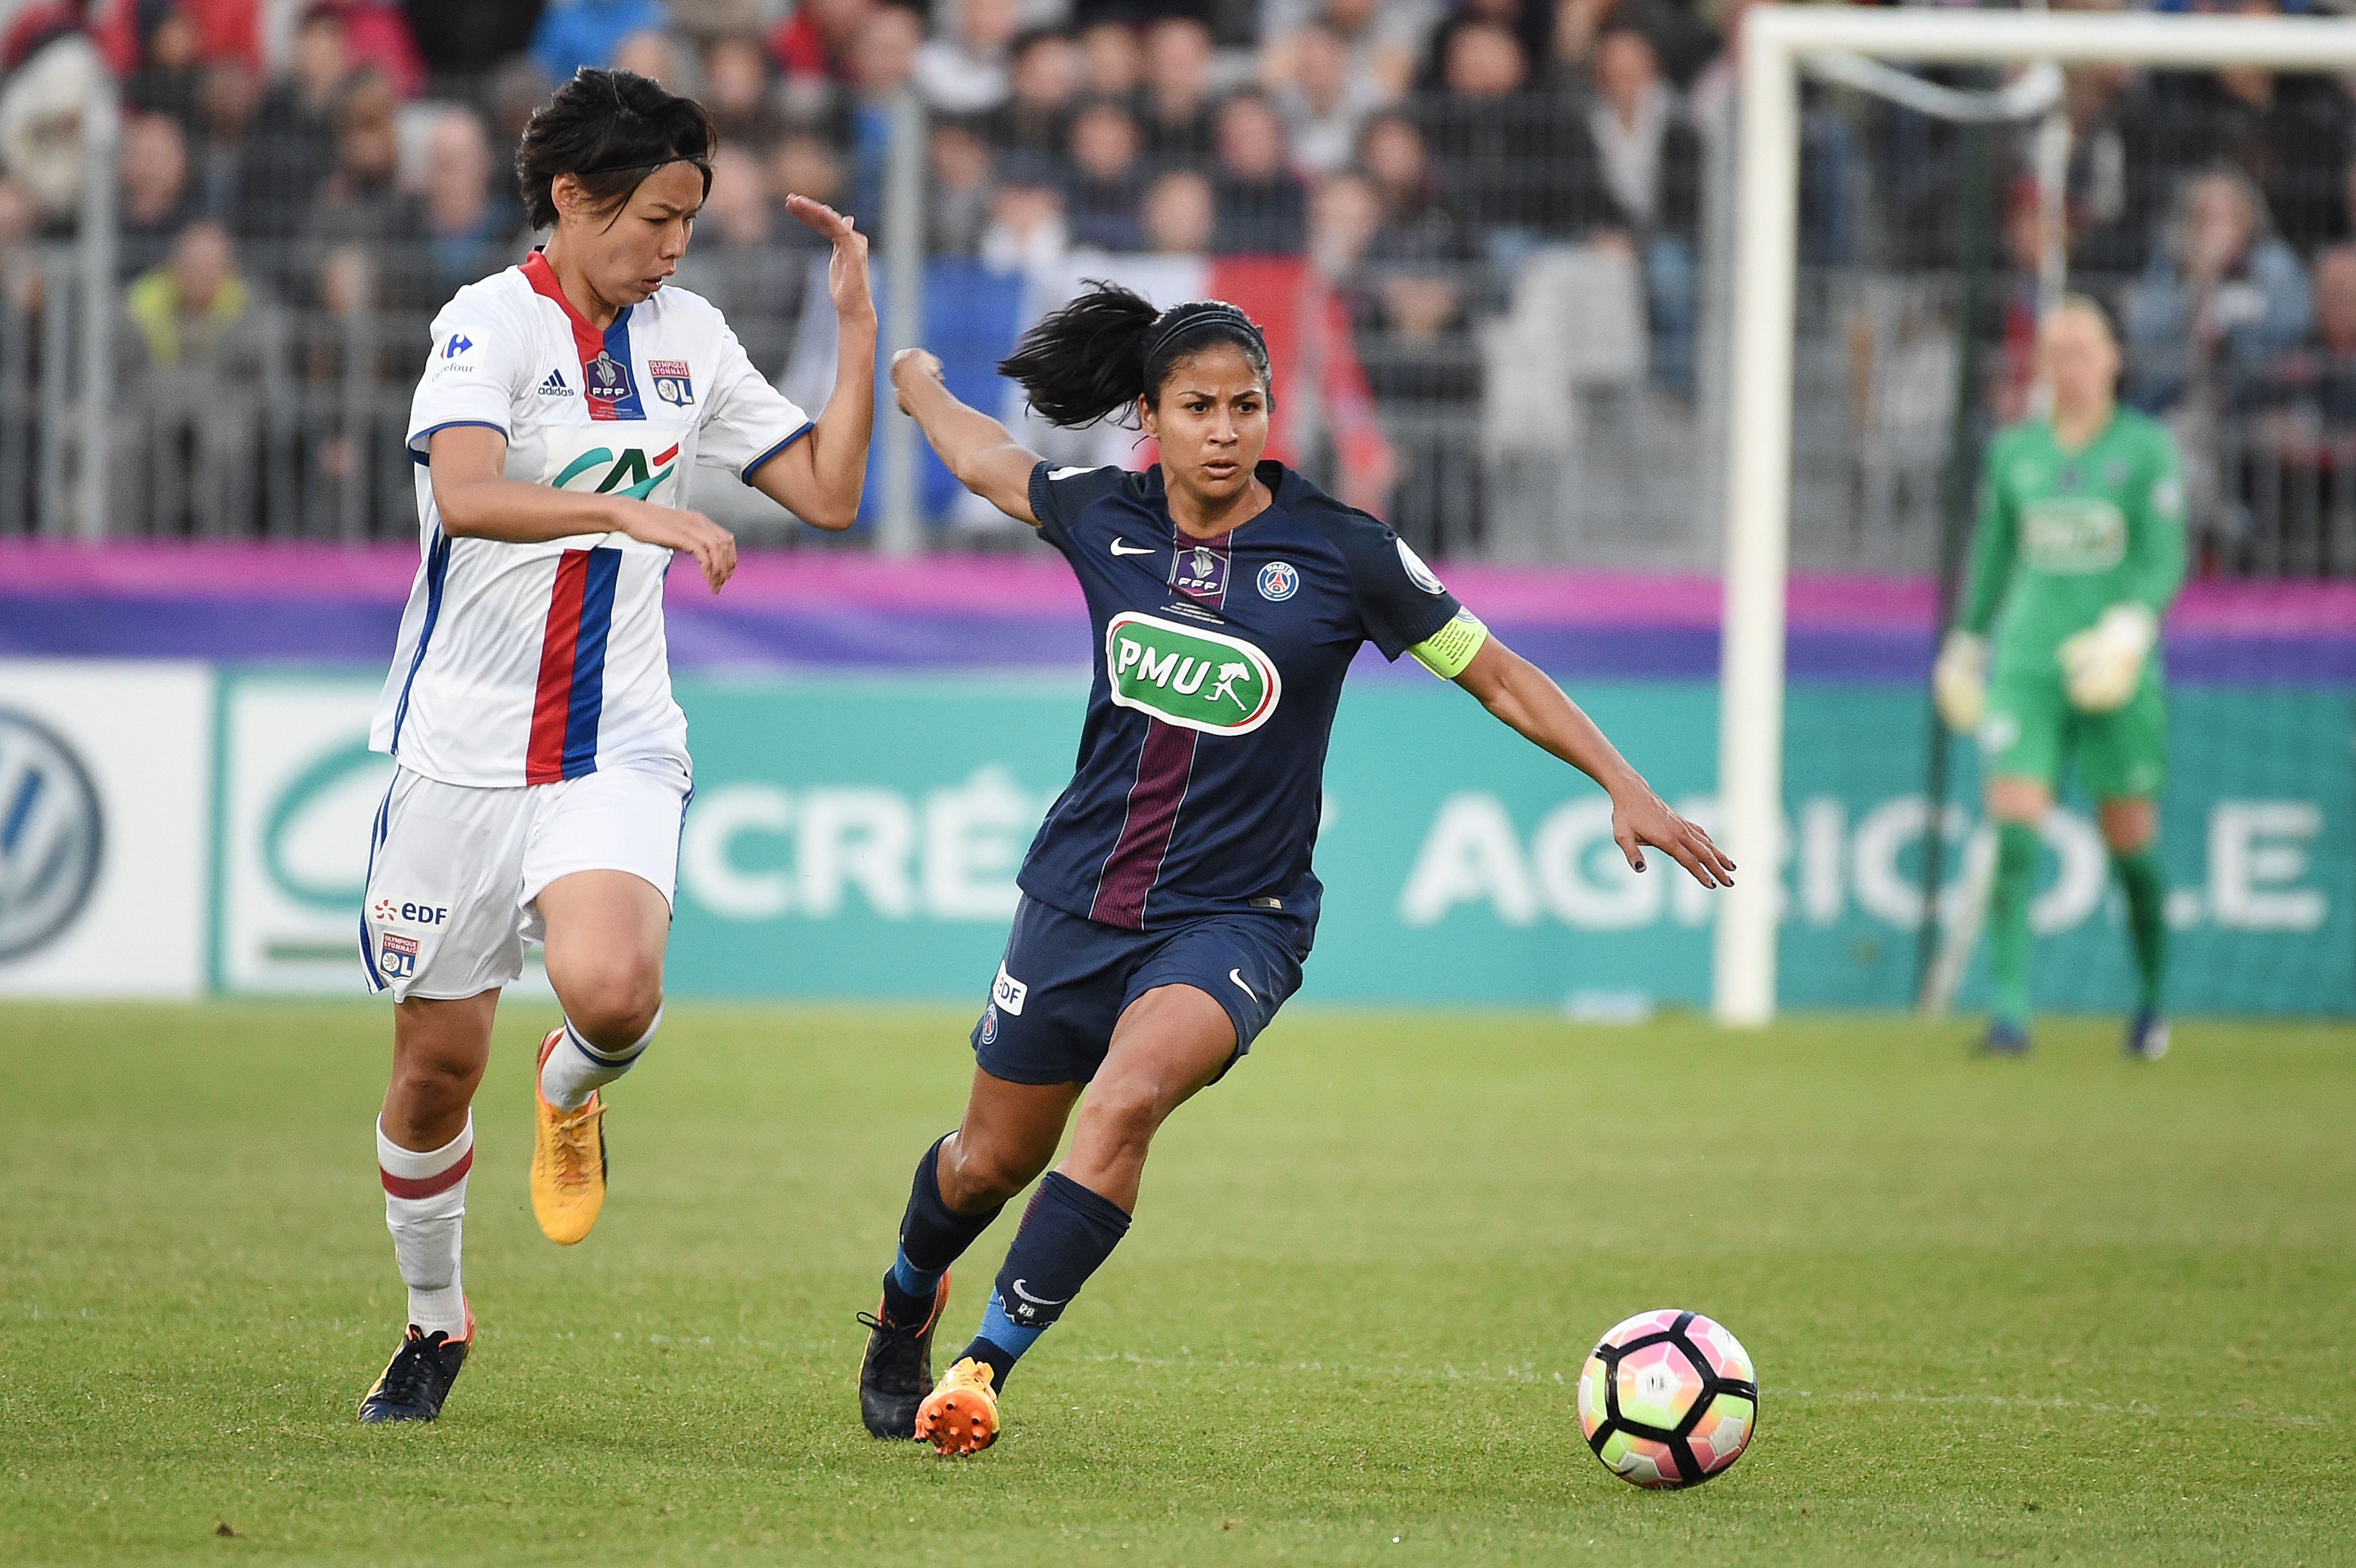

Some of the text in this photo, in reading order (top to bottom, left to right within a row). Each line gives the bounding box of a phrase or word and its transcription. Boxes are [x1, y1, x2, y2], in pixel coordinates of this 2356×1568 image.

[650, 361, 687, 369] OLYMPIQUE
[652, 368, 688, 376] LYONNAIS
[538, 387, 574, 396] adidas
[592, 387, 625, 396] FFF
[1266, 564, 1293, 576] PARIS
[1178, 577, 1218, 590] FFF
[1118, 637, 1211, 695] PMU
[684, 766, 1064, 919] CRÉ
[384, 935, 417, 949] OLYMPIQUE
[384, 941, 416, 954] LYONNAIS
